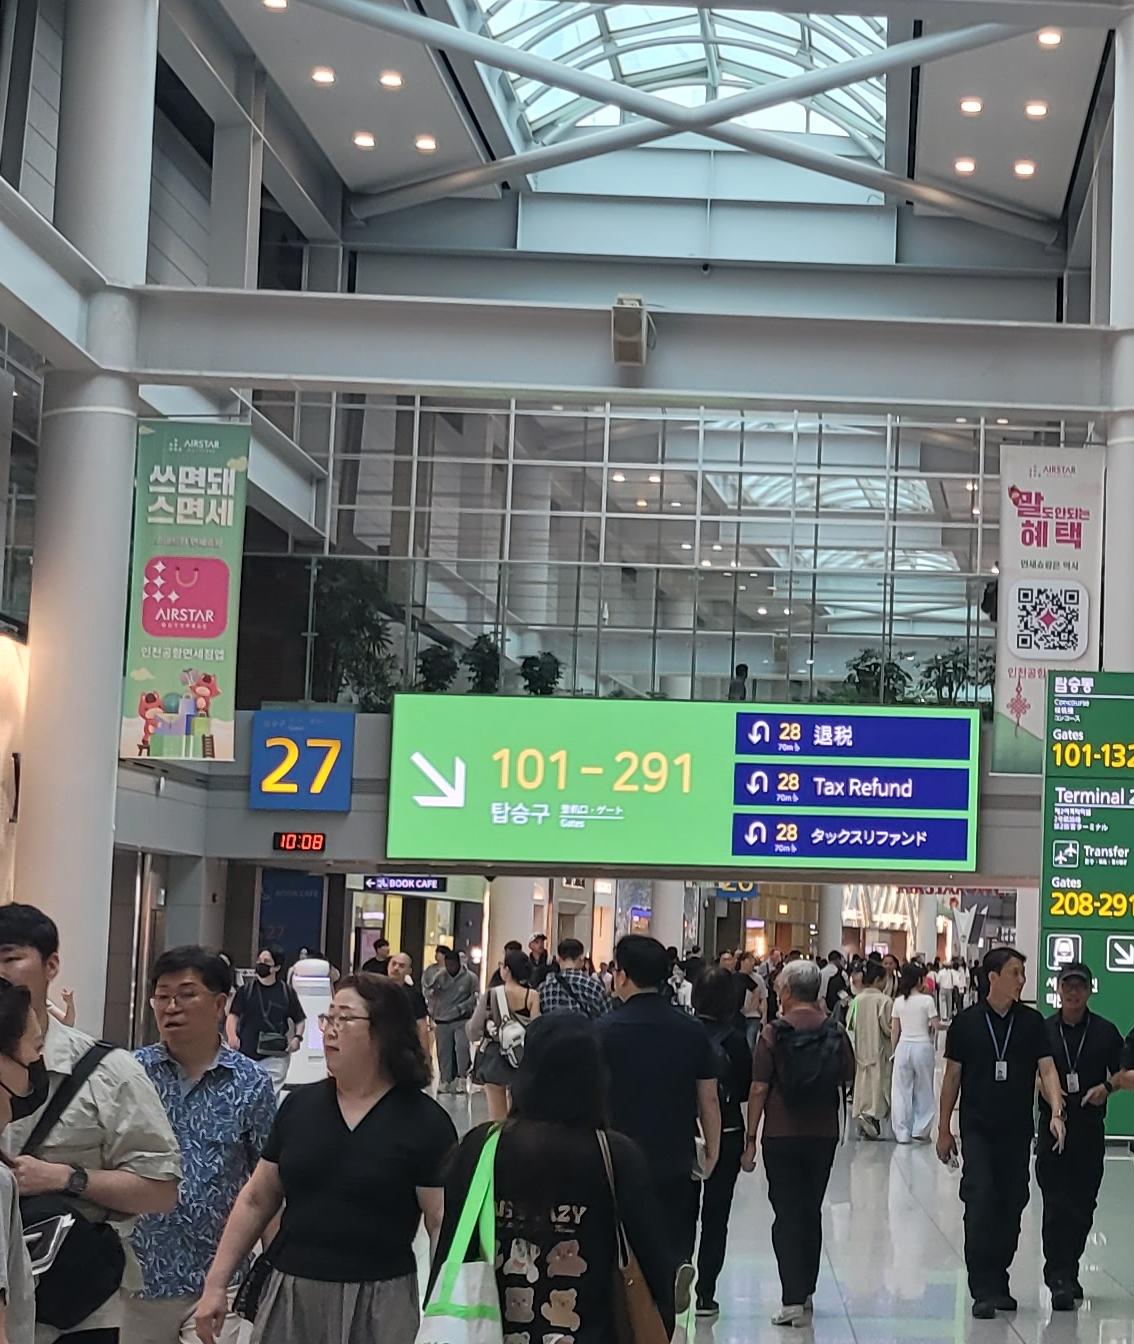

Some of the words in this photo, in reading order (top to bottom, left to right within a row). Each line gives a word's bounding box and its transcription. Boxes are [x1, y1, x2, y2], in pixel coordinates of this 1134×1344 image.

[184, 439, 220, 449] AIRSTAR
[1043, 465, 1076, 474] AIRSTAR
[149, 465, 236, 496] 쓰면돼
[147, 496, 234, 527] 스면세
[155, 608, 214, 622] AIRSTAR
[778, 722, 801, 741] 28
[813, 724, 853, 746] 退税
[1053, 729, 1084, 741] Gates
[261, 736, 342, 794] 27
[491, 748, 568, 790] 101
[612, 750, 692, 794] 291
[777, 773, 799, 791] 28
[813, 777, 844, 796] Tax
[849, 778, 912, 798] Refund
[1055, 787, 1124, 805] Terminal
[491, 802, 550, 825] 탑승구
[775, 823, 798, 841] 28
[811, 828, 927, 847] タックスリファンド
[280, 834, 324, 850] 10:08
[1083, 845, 1129, 857] Transfer
[390, 879, 414, 888] BOOK
[416, 879, 438, 889] CAFE
[1051, 877, 1081, 889] Gates
